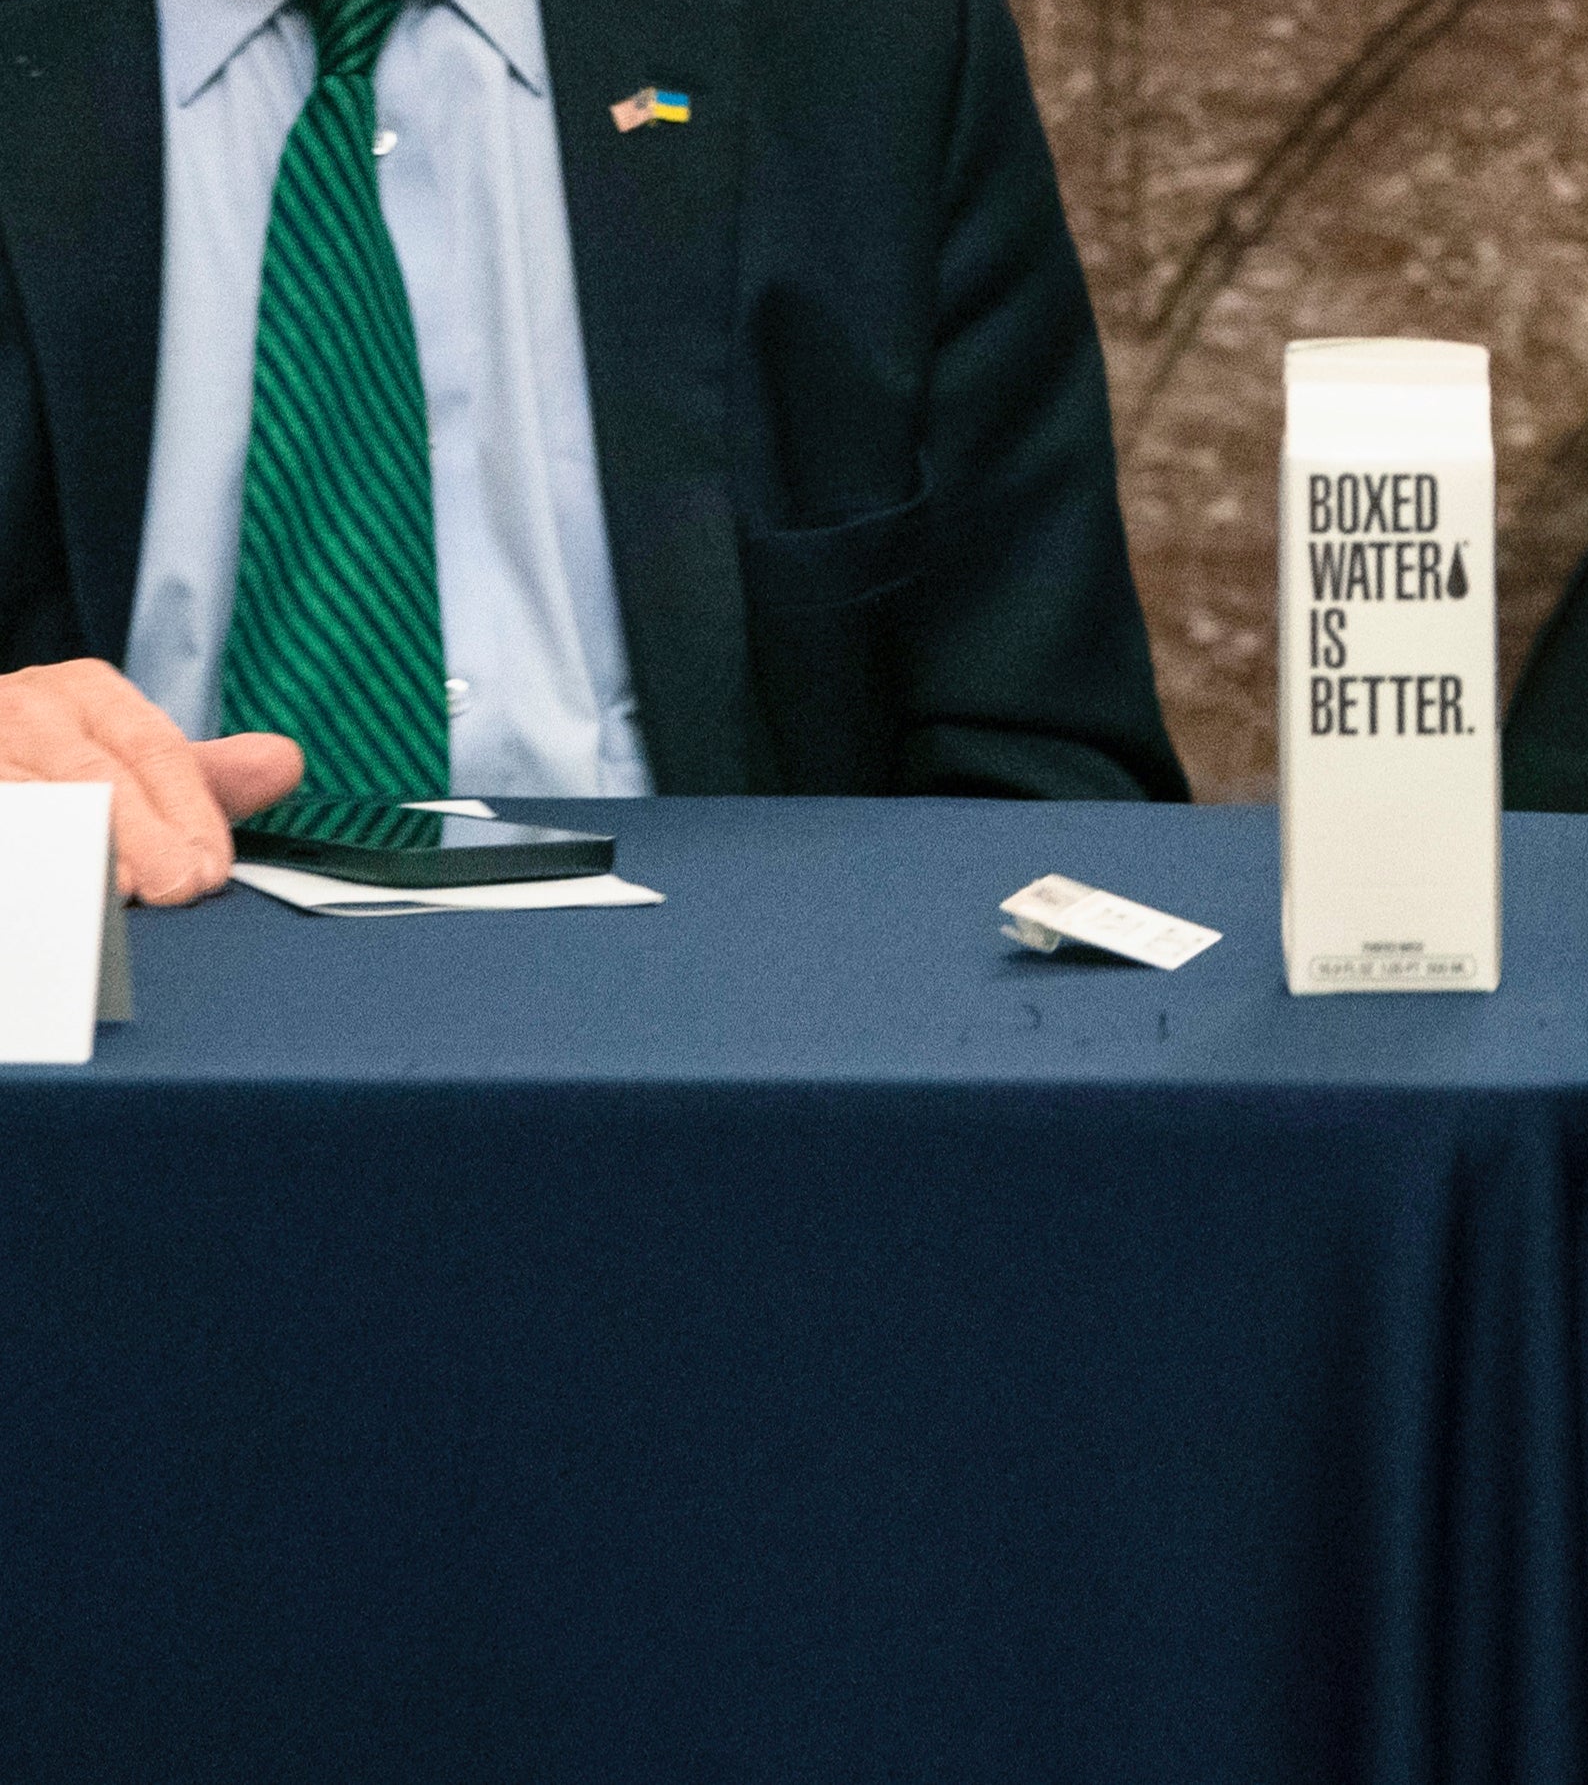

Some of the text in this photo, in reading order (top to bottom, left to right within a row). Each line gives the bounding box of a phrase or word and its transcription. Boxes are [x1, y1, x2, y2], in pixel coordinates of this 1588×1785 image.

[1309, 473, 1438, 534] BOXED
[1309, 540, 1442, 601] WATER
[1309, 607, 1346, 669] IS
[1310, 674, 1475, 736] BETTER.
